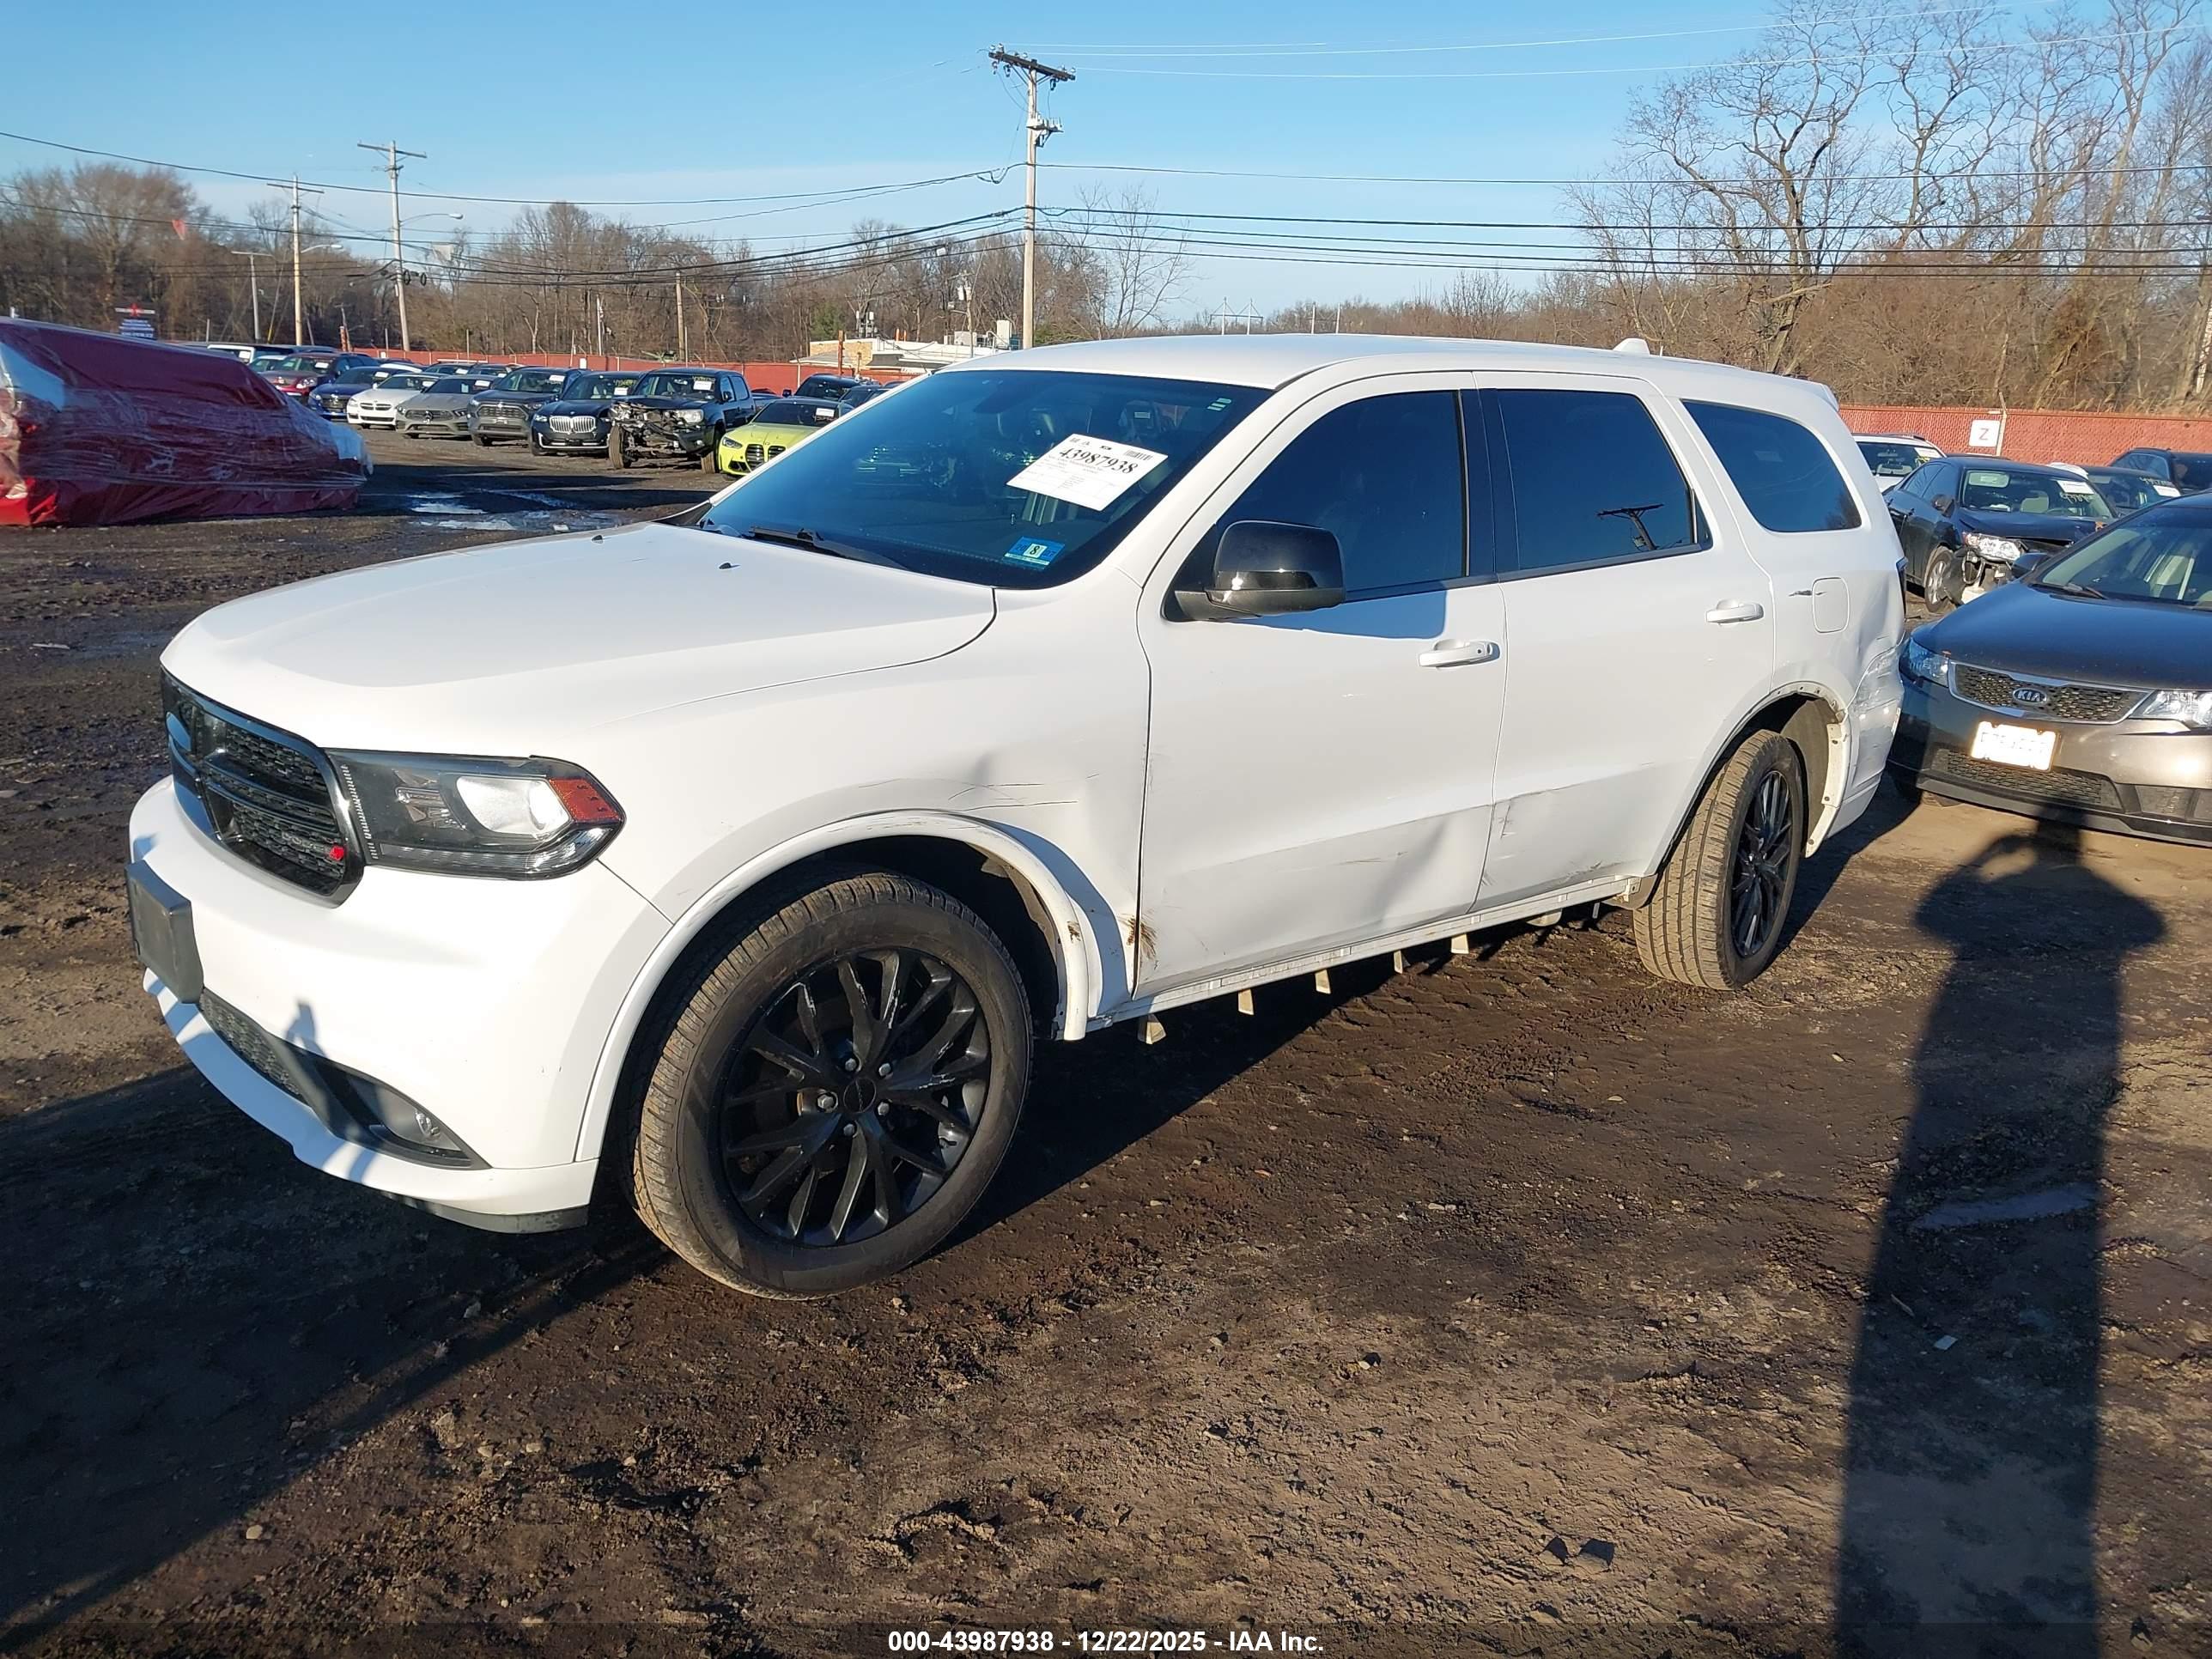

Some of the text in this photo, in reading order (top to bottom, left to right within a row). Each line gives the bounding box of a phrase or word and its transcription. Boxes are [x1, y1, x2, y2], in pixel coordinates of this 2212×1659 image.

[1978, 428, 1989, 441] Z
[1059, 448, 1139, 474] 43987938
[1030, 545, 1040, 555] 8
[2017, 690, 2040, 702] KIA
